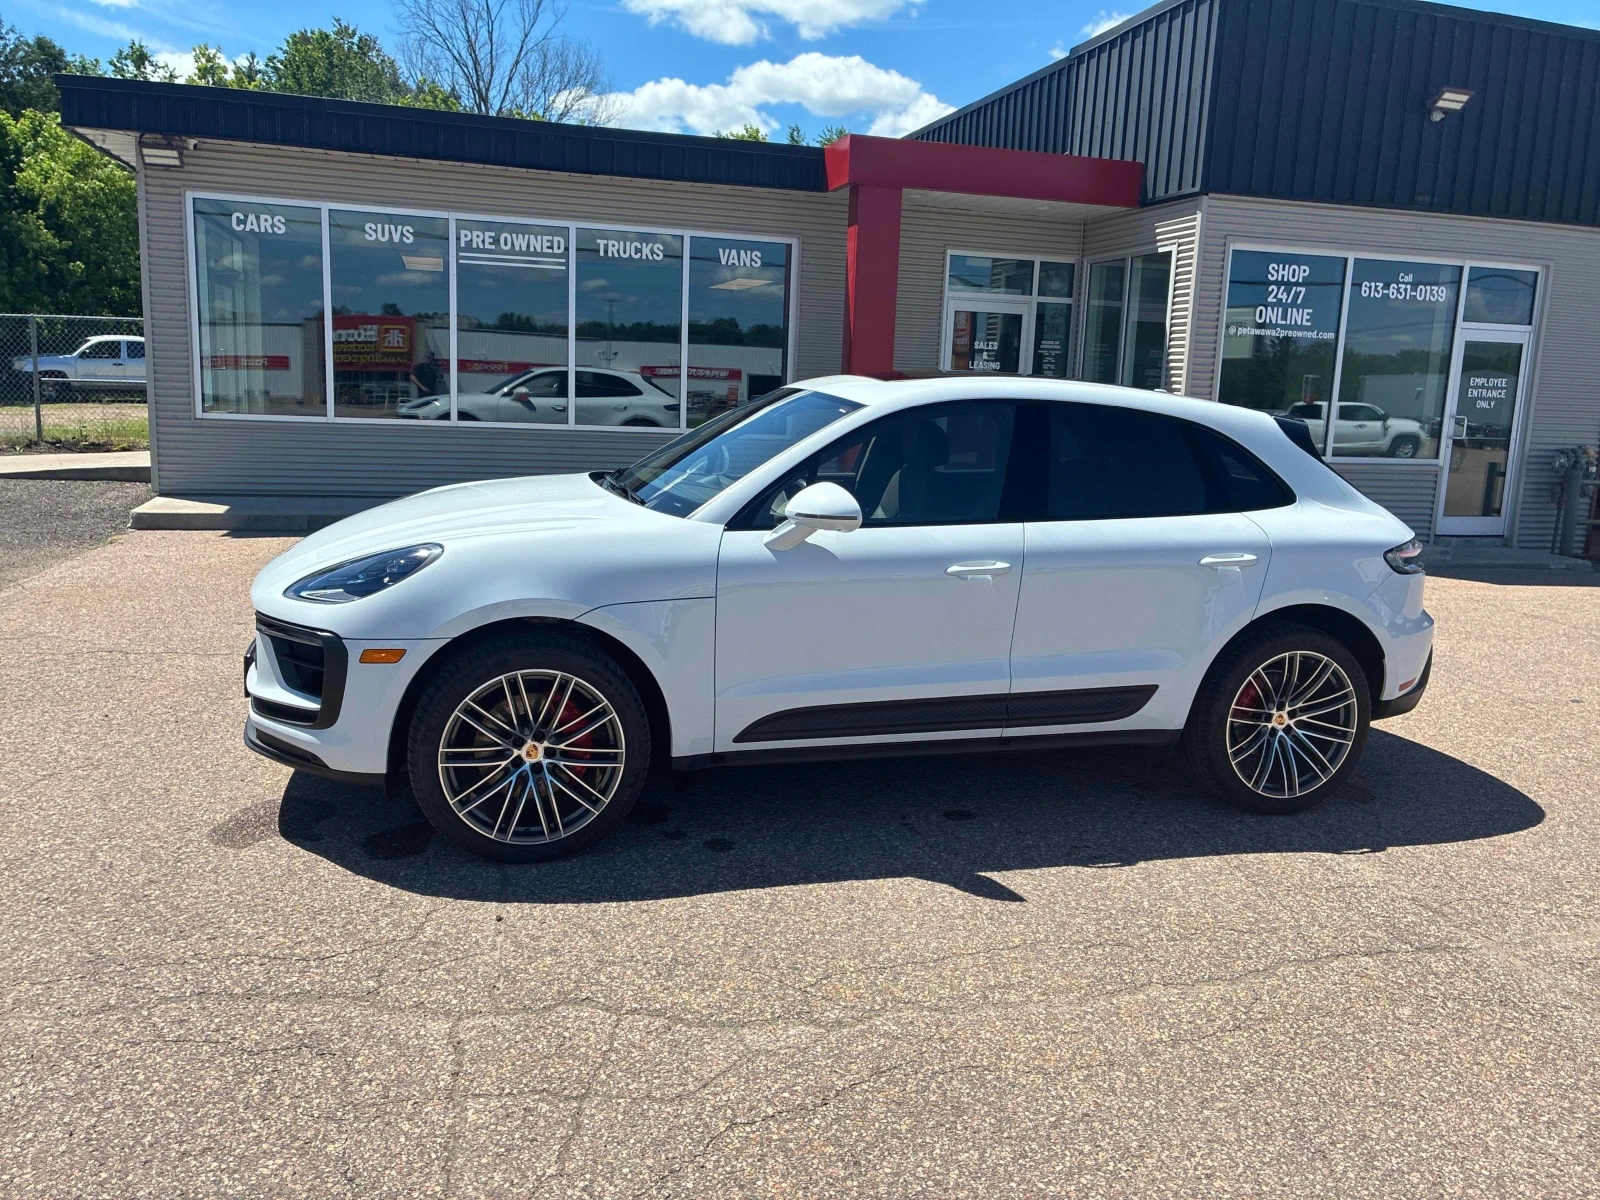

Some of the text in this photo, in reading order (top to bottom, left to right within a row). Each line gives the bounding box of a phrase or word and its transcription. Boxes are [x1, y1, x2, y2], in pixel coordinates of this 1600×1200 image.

[231, 211, 286, 235] CARS
[364, 222, 415, 244] SUVS
[459, 229, 565, 254] PRE OWNED
[596, 238, 665, 261] TRUCKS
[718, 248, 762, 268] VANS
[1267, 263, 1310, 283] SHOP
[1398, 272, 1413, 283] Call
[1267, 284, 1306, 305] 24/7
[1360, 281, 1447, 302] 613-631-0139
[1255, 305, 1313, 326] ONLINE
[1228, 325, 1335, 340] @ petawawa2preowned.com
[973, 341, 998, 351] SALES
[982, 351, 989, 360] &
[968, 360, 1000, 371] LEASING
[1469, 377, 1508, 388] EMPLOYEE
[1467, 388, 1507, 399] ENTRANCE
[1475, 399, 1496, 409] ONLY
